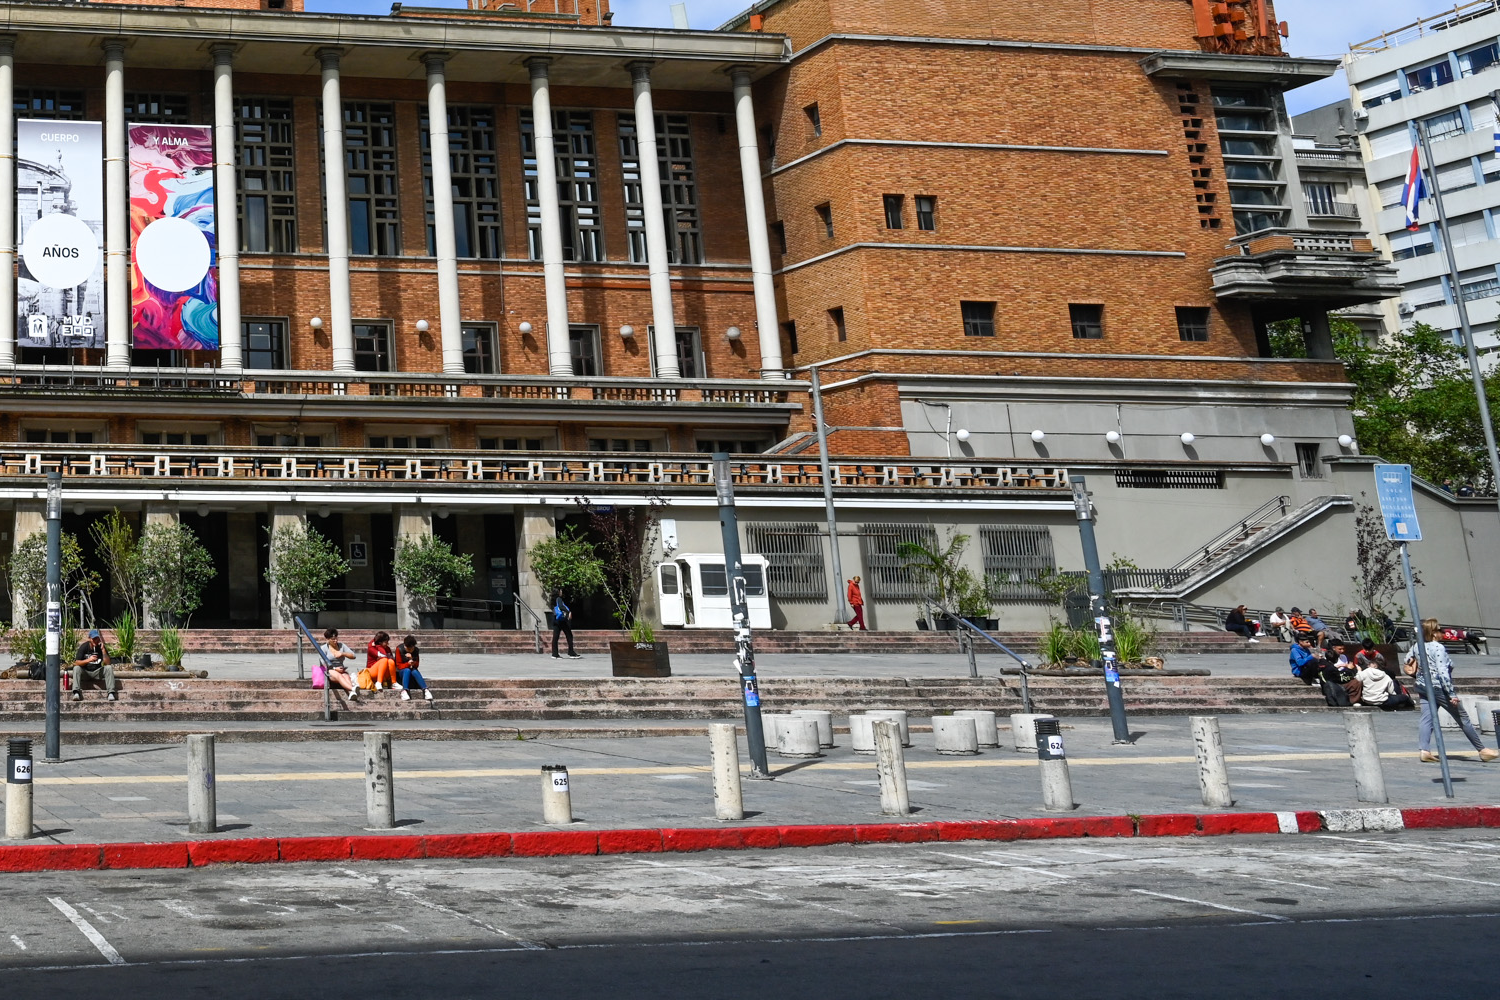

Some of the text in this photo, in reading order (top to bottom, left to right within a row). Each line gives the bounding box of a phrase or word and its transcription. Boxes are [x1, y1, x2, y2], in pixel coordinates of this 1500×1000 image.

[40, 132, 80, 143] CUERPO
[152, 136, 189, 146] Y ALMA
[42, 243, 79, 259] AÑOS
[63, 316, 92, 325] MVD
[16, 765, 31, 774] 626
[554, 777, 568, 786] 625
